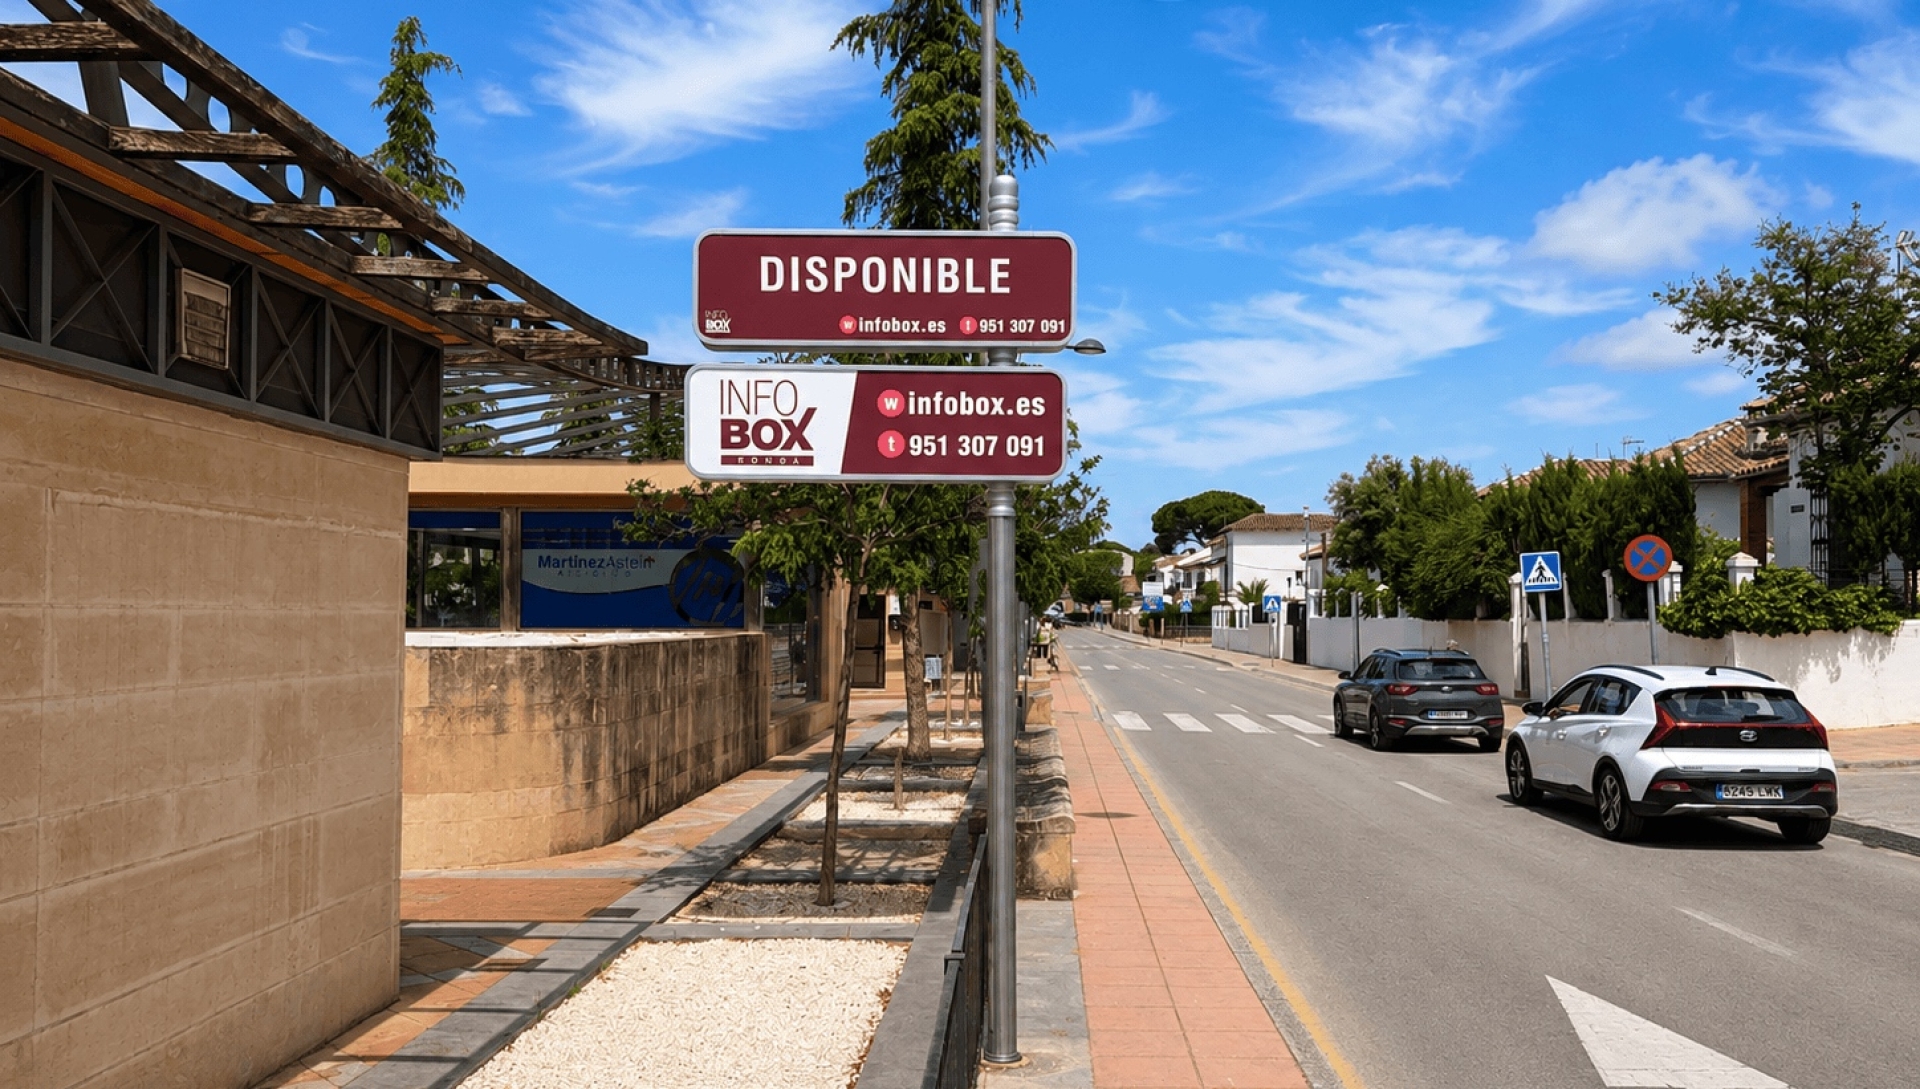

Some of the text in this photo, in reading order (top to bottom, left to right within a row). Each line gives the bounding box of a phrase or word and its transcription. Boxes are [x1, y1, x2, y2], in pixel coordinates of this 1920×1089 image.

[760, 255, 1010, 294] DISPONIBLE
[858, 317, 946, 333] infobox.es
[979, 319, 1004, 333] 951
[1009, 319, 1035, 333] 307
[1040, 319, 1065, 334] 091
[720, 379, 798, 416] INFO
[908, 390, 1046, 416] infobox.es
[720, 407, 817, 451] BOX
[909, 434, 947, 457] 951
[957, 434, 998, 457] 307
[1006, 434, 1044, 457] 091
